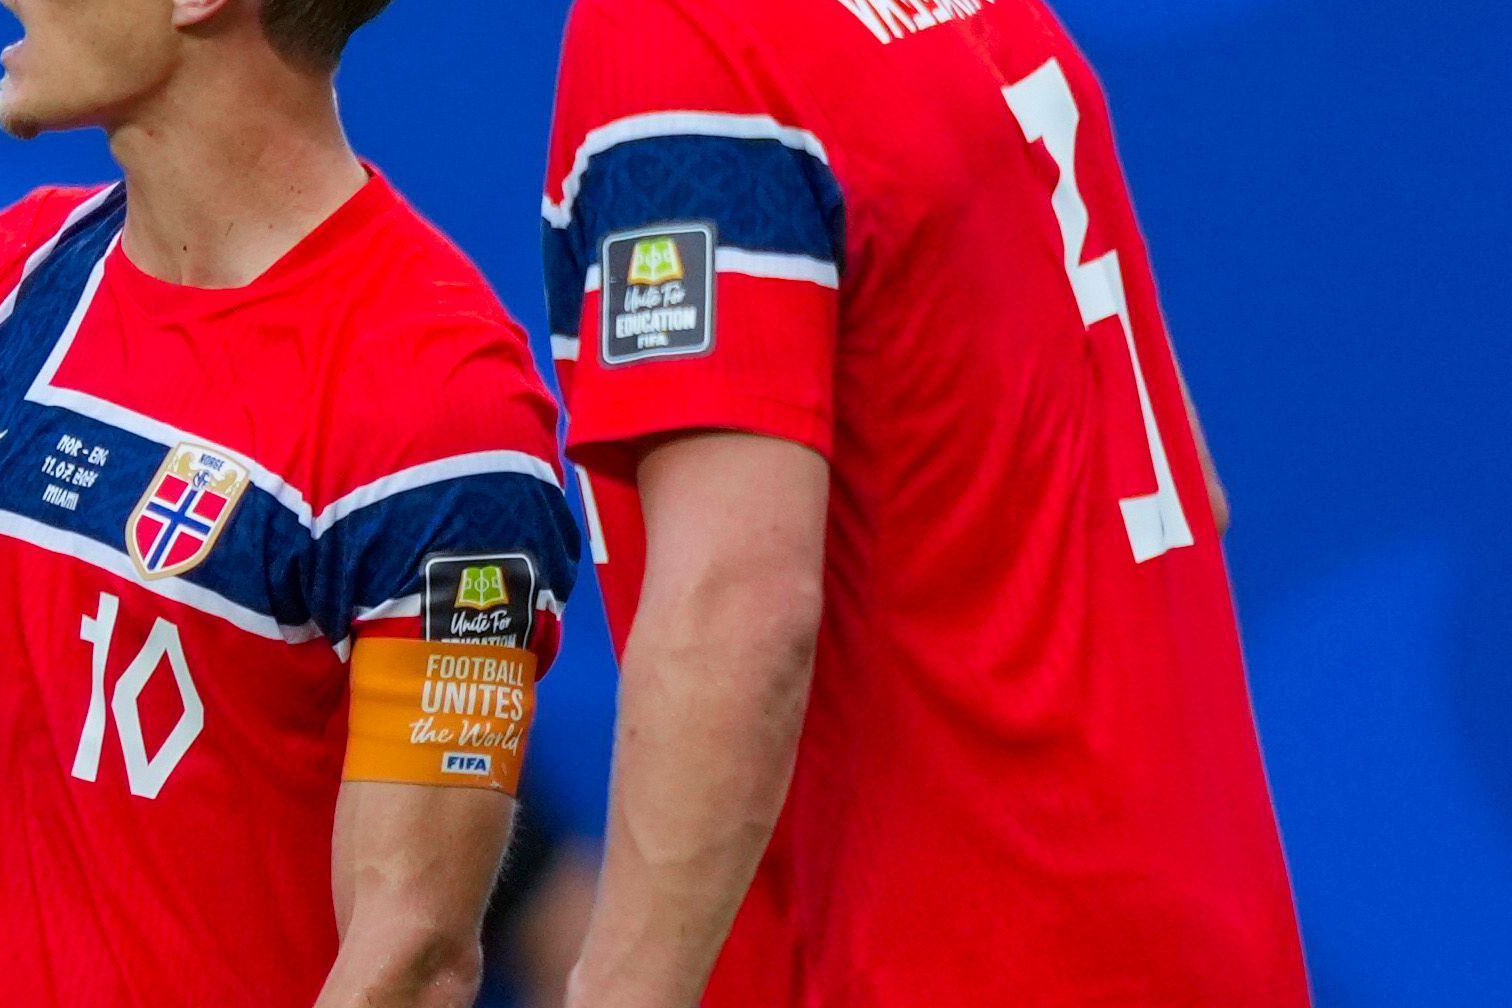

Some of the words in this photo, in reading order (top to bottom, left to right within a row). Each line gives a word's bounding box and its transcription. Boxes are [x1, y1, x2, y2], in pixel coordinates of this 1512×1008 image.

[615, 305, 697, 339] EDUCATION
[1002, 57, 1194, 564] 3
[56, 434, 83, 457] NOR
[42, 484, 79, 511] MIAMI
[451, 611, 490, 637] Unite
[490, 609, 512, 634] For
[426, 654, 524, 687] FOOTBALL
[71, 591, 204, 799] 10
[421, 680, 524, 721] UNITES
[409, 717, 454, 744] the
[458, 719, 524, 756] World
[446, 756, 487, 772] FIFA
